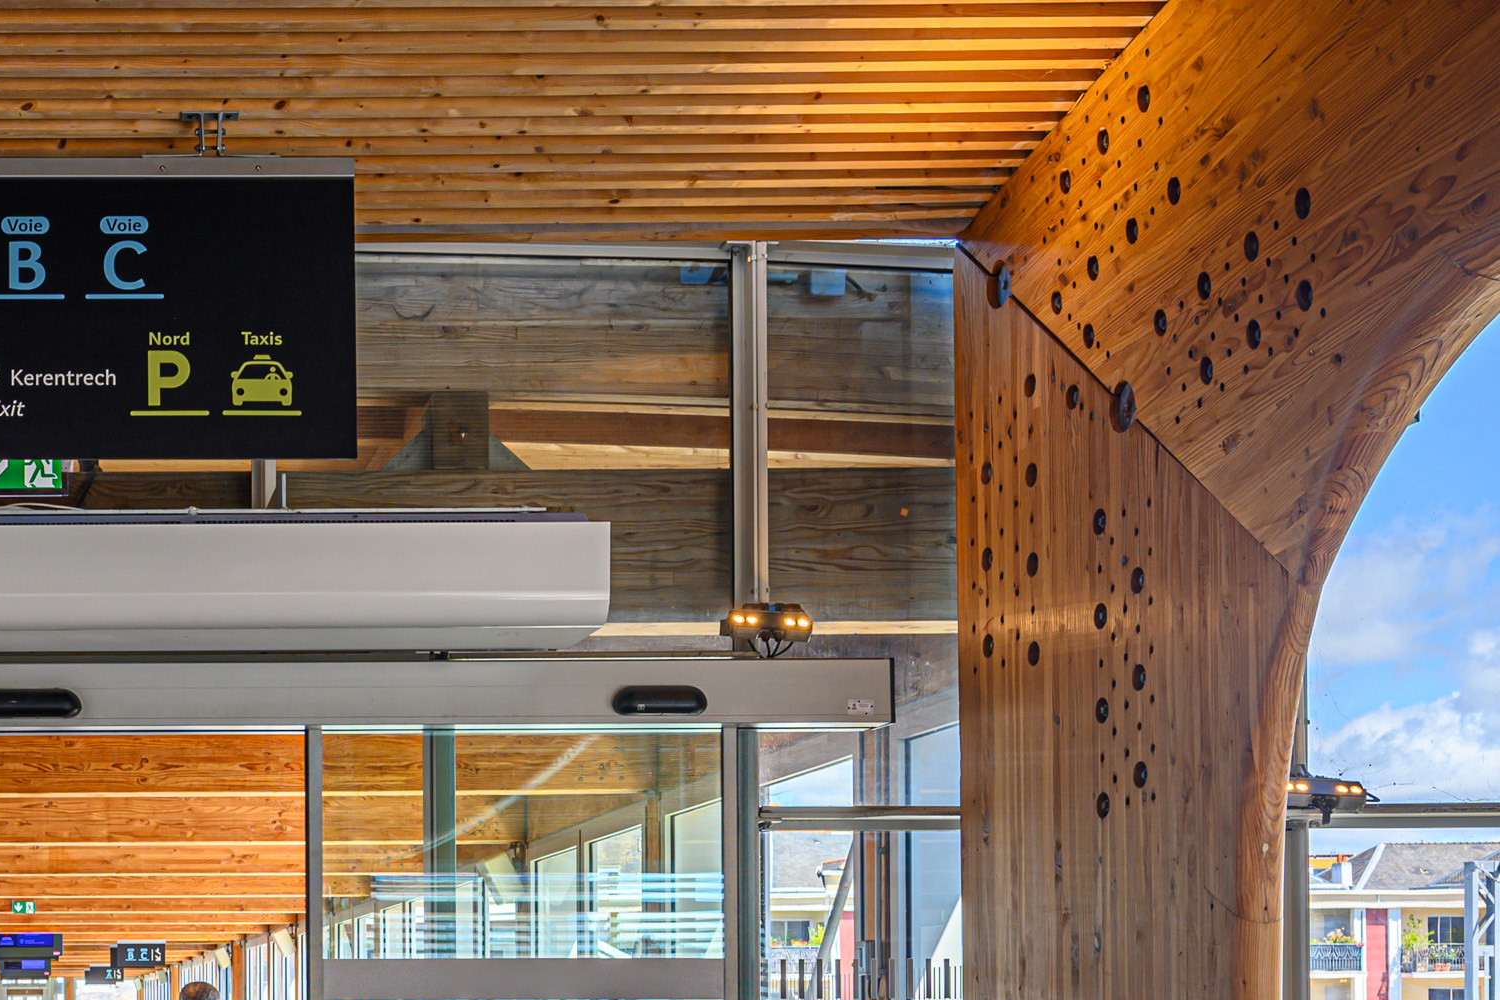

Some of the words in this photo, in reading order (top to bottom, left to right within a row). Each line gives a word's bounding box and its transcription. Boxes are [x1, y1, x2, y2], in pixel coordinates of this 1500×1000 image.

[7, 218, 43, 232] Voie
[106, 217, 142, 232] Voie
[8, 240, 46, 290] B
[103, 240, 147, 290] C
[149, 331, 190, 346] Nord
[241, 331, 282, 346] Taxis
[10, 369, 117, 386] Kerentrech
[147, 350, 191, 406] P
